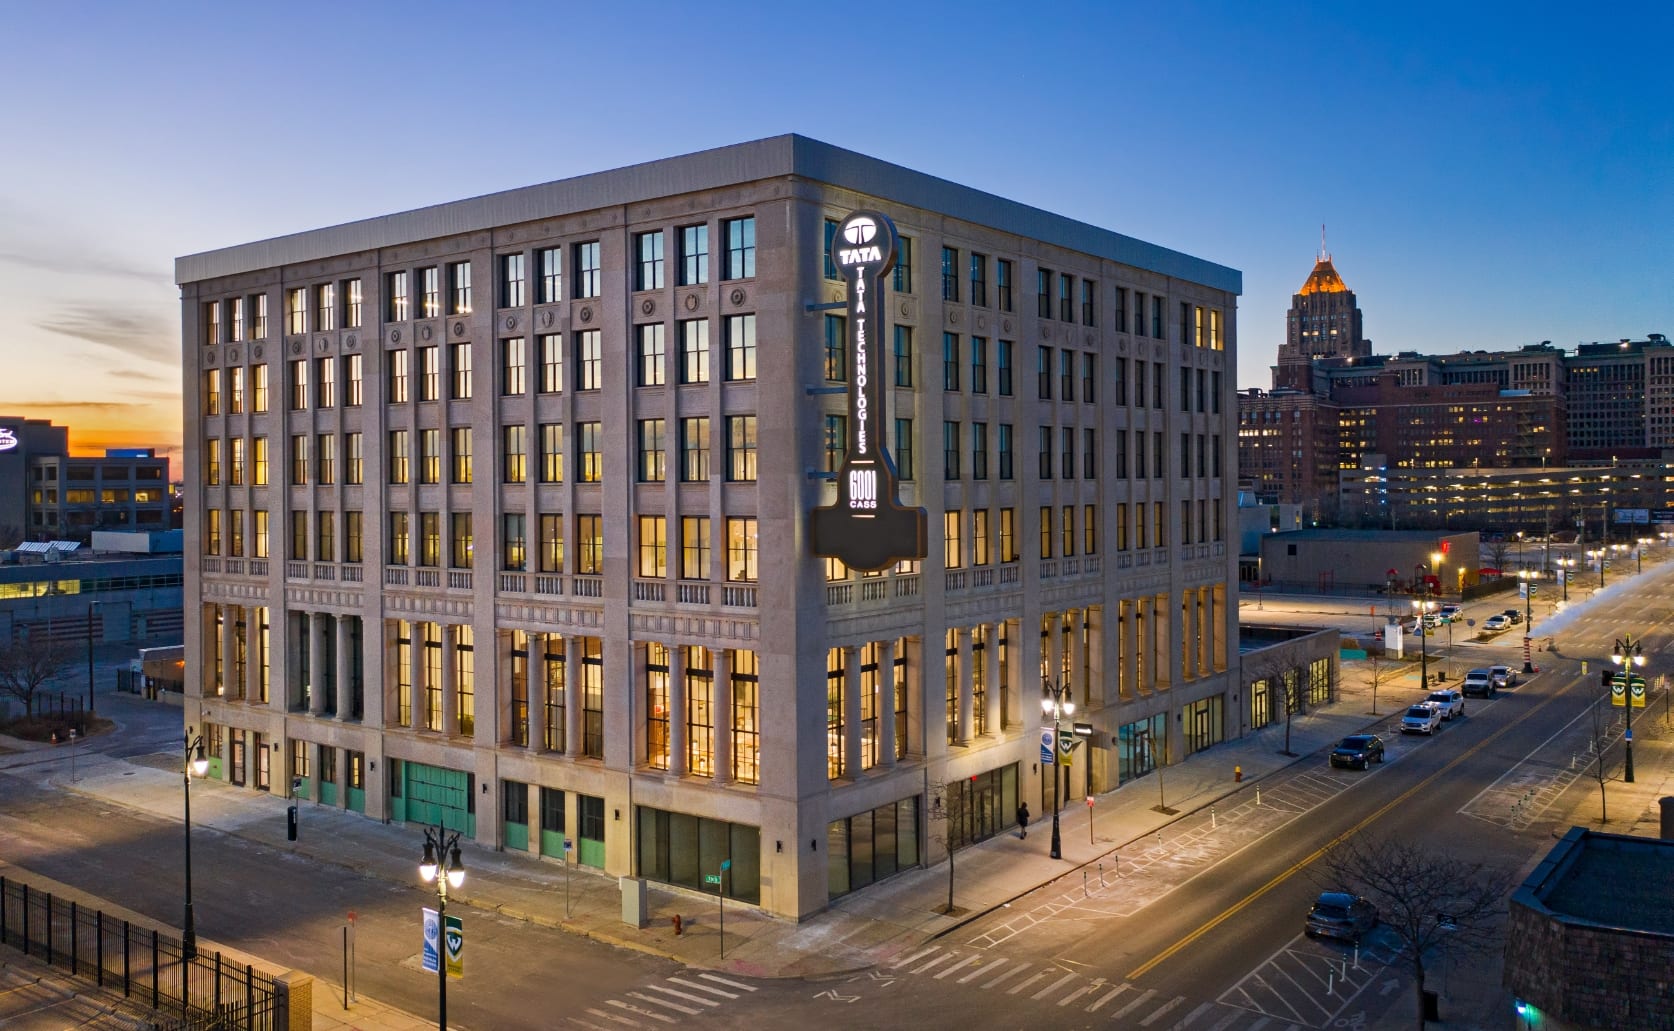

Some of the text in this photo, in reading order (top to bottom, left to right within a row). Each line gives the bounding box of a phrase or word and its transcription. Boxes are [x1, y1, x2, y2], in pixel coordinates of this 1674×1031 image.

[840, 246, 882, 265] TATA
[856, 267, 868, 454] TATA TECHNOLOGIES
[849, 470, 877, 500] 6001
[849, 500, 877, 509] CASS
[447, 935, 462, 950] W
